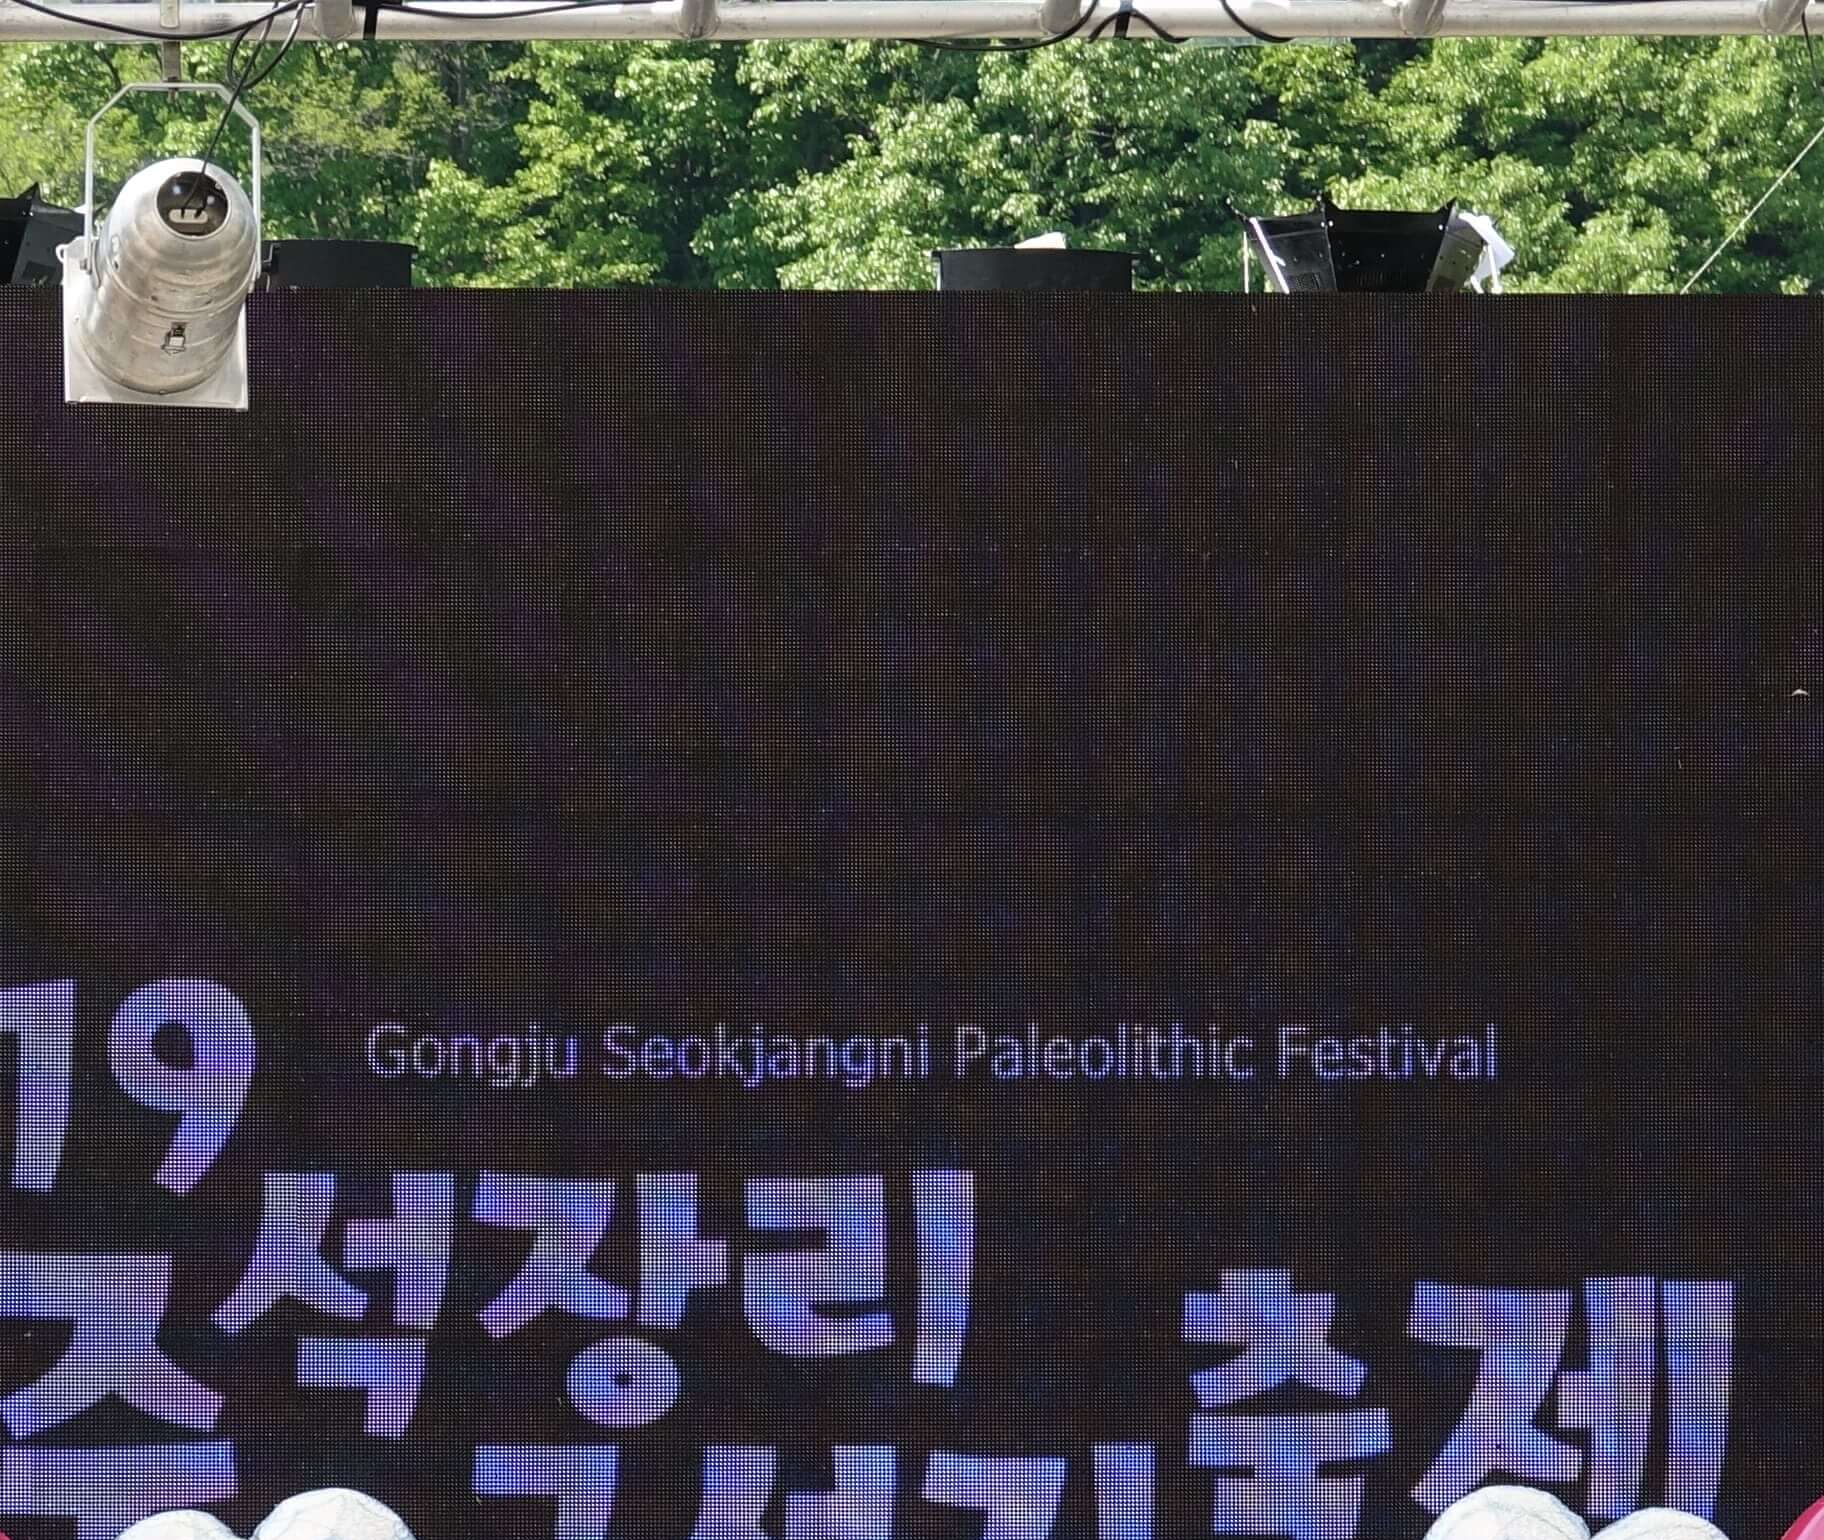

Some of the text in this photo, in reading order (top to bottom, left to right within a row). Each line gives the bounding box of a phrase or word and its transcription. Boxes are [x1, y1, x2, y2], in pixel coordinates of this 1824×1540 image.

[365, 1022, 1497, 1088] Gongju Seokjangni Paleolithic Festival
[212, 1170, 972, 1434] 석장리
